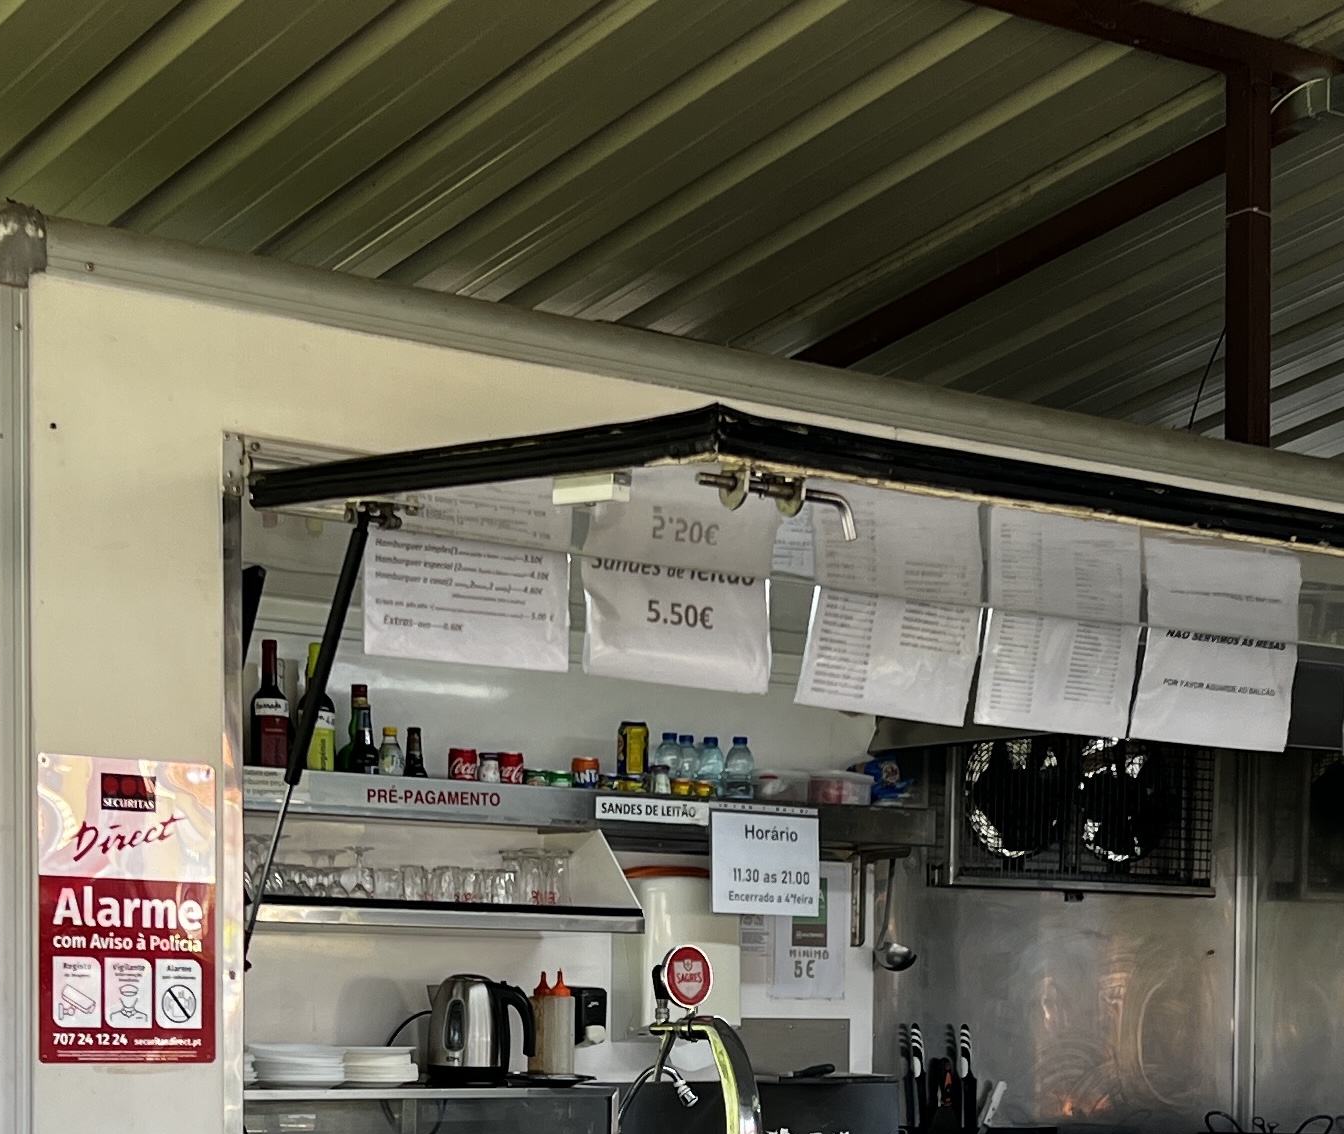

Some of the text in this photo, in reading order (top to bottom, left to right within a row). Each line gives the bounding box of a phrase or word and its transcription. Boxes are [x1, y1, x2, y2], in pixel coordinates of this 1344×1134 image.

[666, 564, 687, 580] de
[646, 600, 714, 630] 5.50€
[103, 798, 155, 810] SECURITAS
[367, 785, 501, 807] PRÉ-PAGAMENTO
[601, 802, 696, 818] SANDES DE LEITÃO
[72, 814, 188, 862] Direct
[745, 824, 798, 843] Horário
[733, 868, 810, 886] 11.30 as 21.00
[728, 890, 775, 904] Encerrado
[777, 896, 782, 904] a
[53, 886, 204, 931] Alarme
[53, 932, 203, 953] com Aviso à Polícia
[676, 972, 703, 984] SAGRES
[52, 1033, 128, 1046] 707 24 12 24
